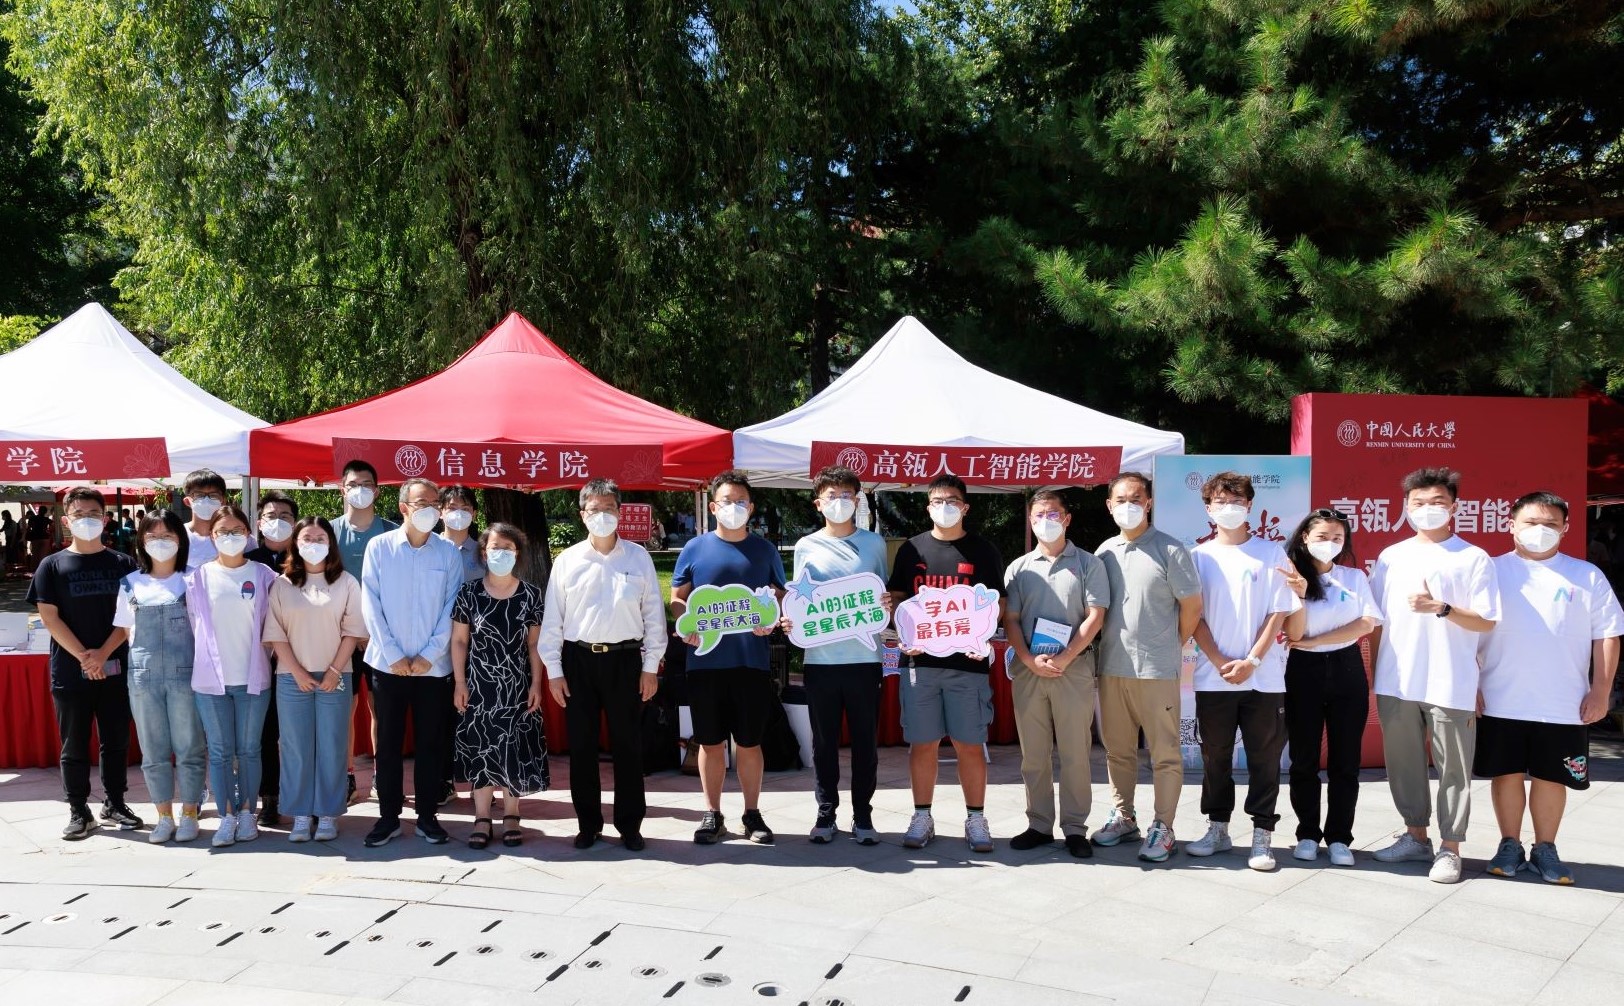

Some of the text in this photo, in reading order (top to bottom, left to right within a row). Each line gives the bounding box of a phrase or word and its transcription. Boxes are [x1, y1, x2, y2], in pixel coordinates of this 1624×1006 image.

[1366, 420, 1456, 439] 中國人民大學
[6, 446, 88, 476] 学院
[436, 447, 589, 479] 信息学院
[872, 449, 1096, 480] 高瓴人工智能学院
[697, 598, 751, 615] AI的征程
[806, 589, 875, 616] AI的征程
[925, 598, 967, 617] 学AI
[696, 612, 760, 632] 是星辰大海
[802, 606, 884, 637] 是星辰大海
[916, 617, 971, 640] 最有爱
